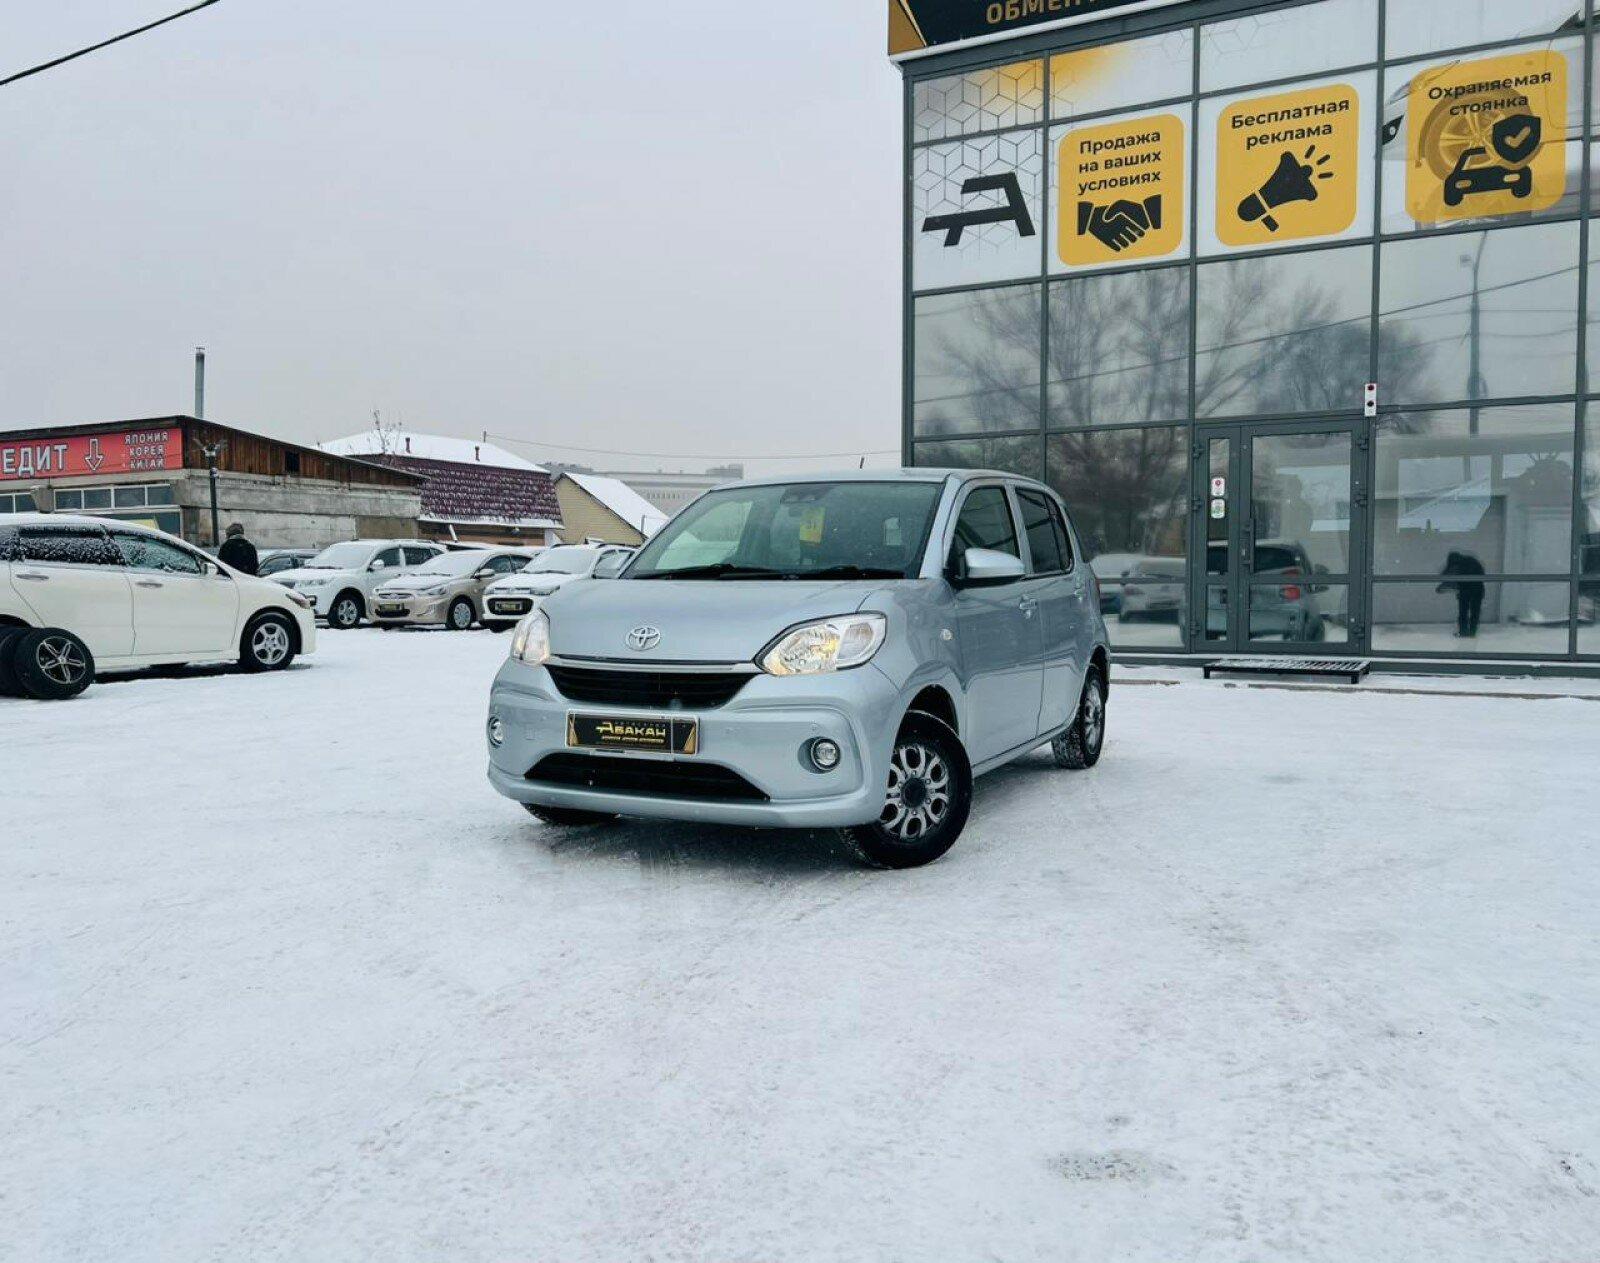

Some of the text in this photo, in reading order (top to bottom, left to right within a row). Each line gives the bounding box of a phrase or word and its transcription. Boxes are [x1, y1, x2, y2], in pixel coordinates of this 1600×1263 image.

[1428, 71, 1552, 100] Охраняемая
[1231, 98, 1350, 129] Бесплатная
[1449, 95, 1529, 116] стоянка
[1079, 130, 1161, 154] Продажа
[1245, 122, 1333, 150] реклама
[1078, 151, 1162, 175] на ваших
[1077, 171, 1161, 196] условиях
[125, 431, 168, 445] ЯПОНИЯ
[130, 444, 165, 457] КОРЕЯ
